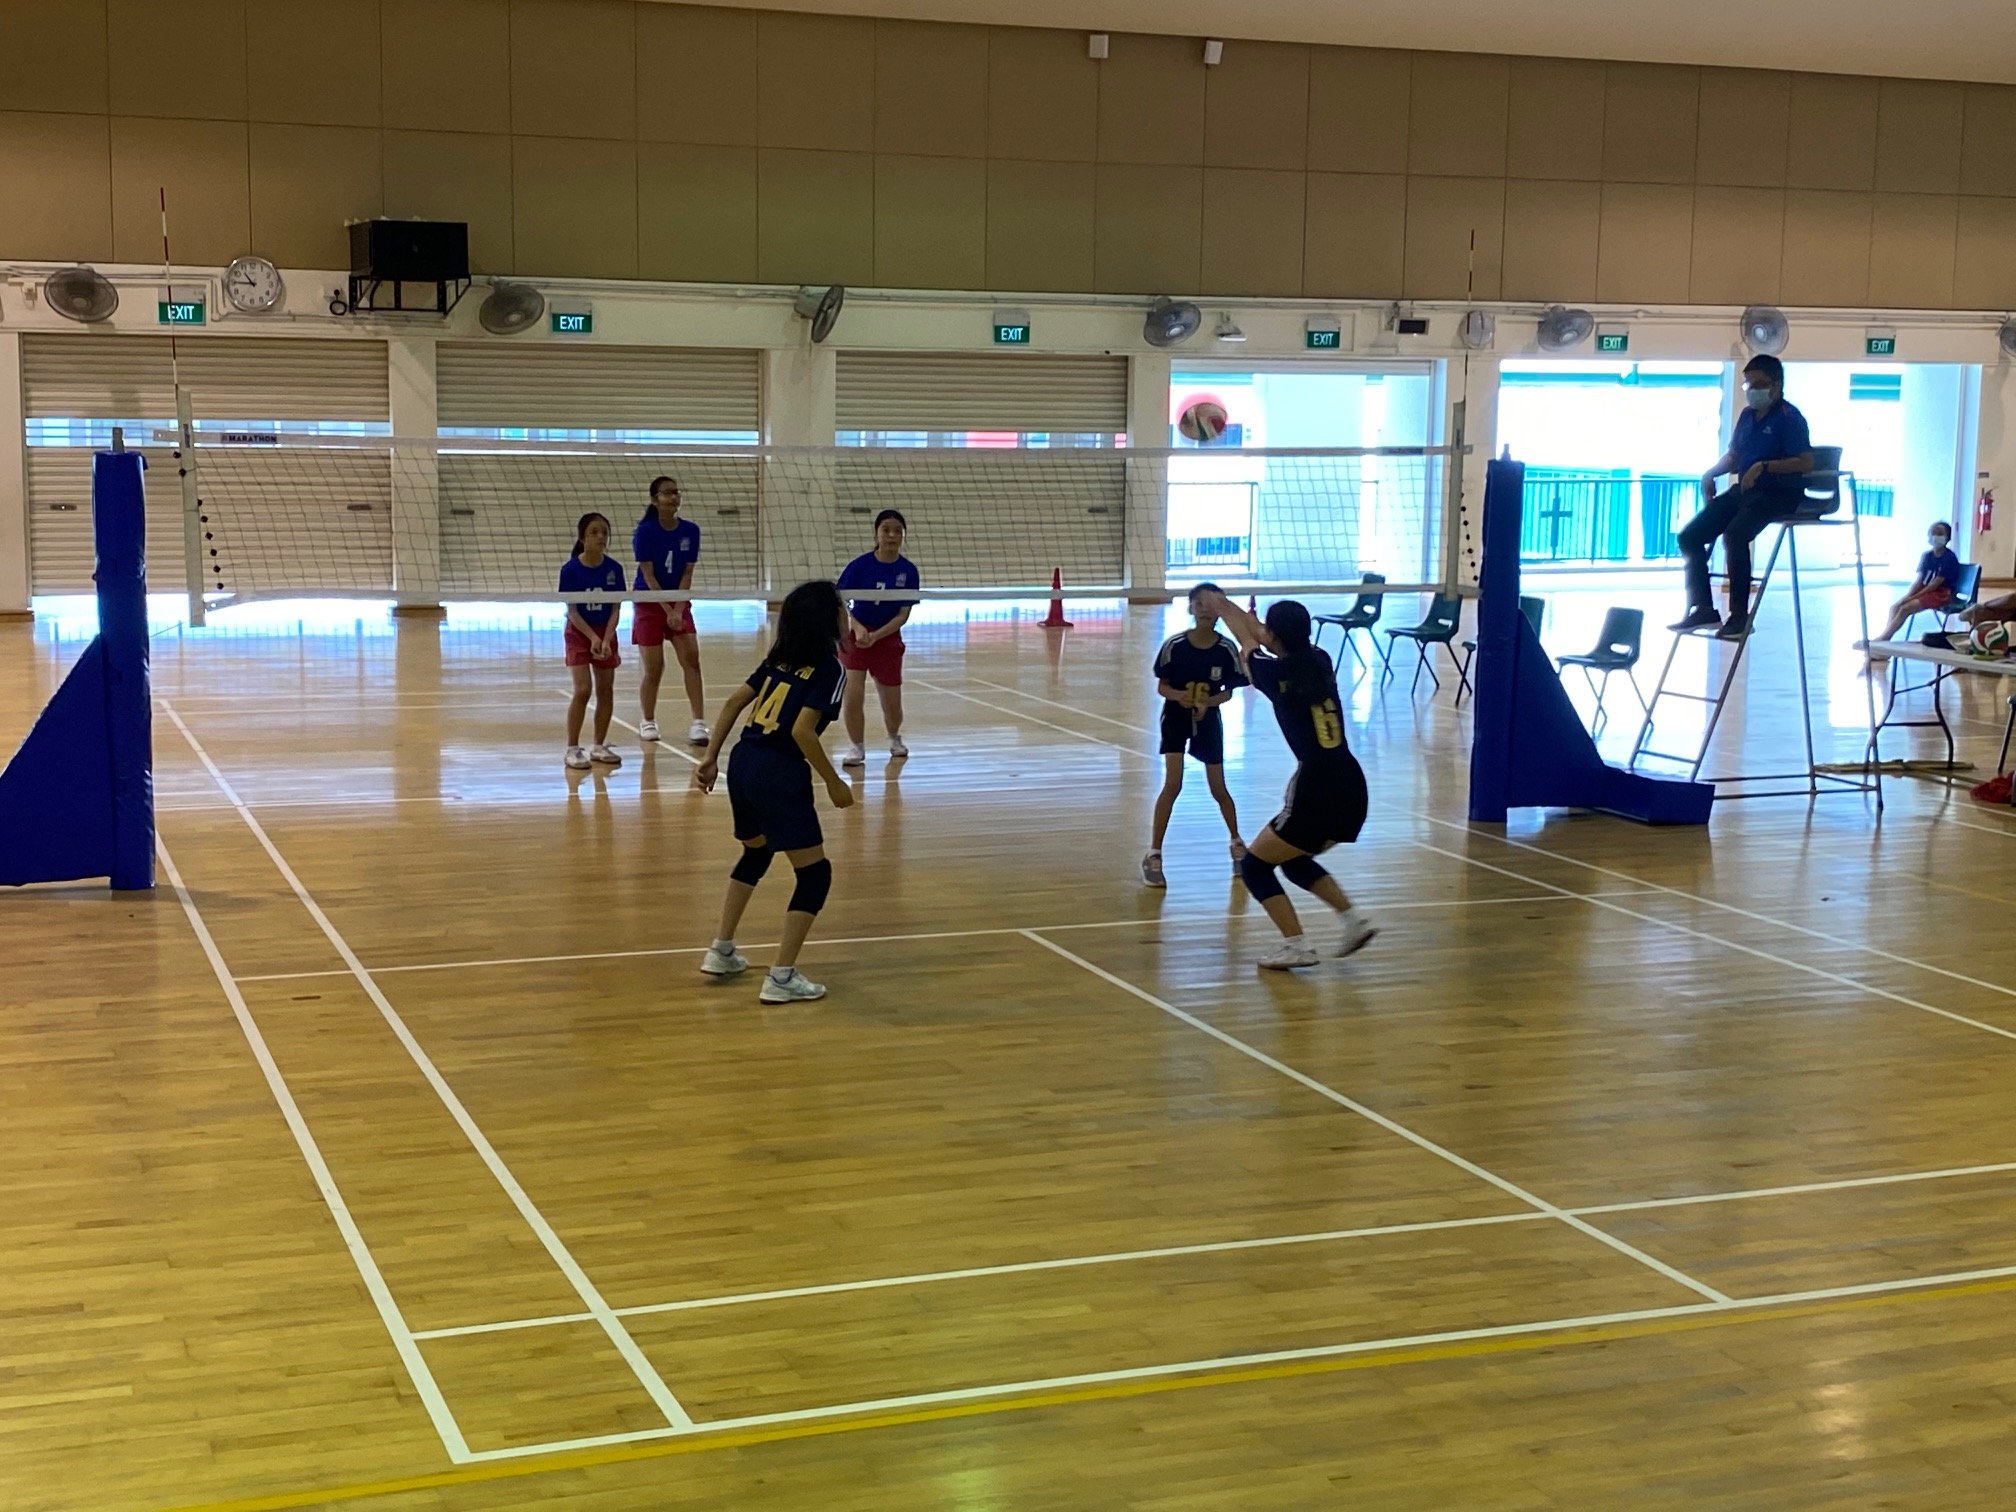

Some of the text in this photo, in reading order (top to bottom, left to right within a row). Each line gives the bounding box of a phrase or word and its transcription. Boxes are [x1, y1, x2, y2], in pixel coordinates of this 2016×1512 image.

[167, 305, 194, 320] EXIT
[559, 315, 585, 330] EXIT
[1000, 327, 1024, 341] EXIT
[1313, 332, 1334, 346] EXIT
[1602, 336, 1623, 350] EXIT
[1871, 340, 1890, 353] EXIT
[228, 434, 278, 443] MARATHON
[664, 550, 673, 574] 4
[747, 676, 792, 735] 14
[1310, 697, 1342, 749] 6
